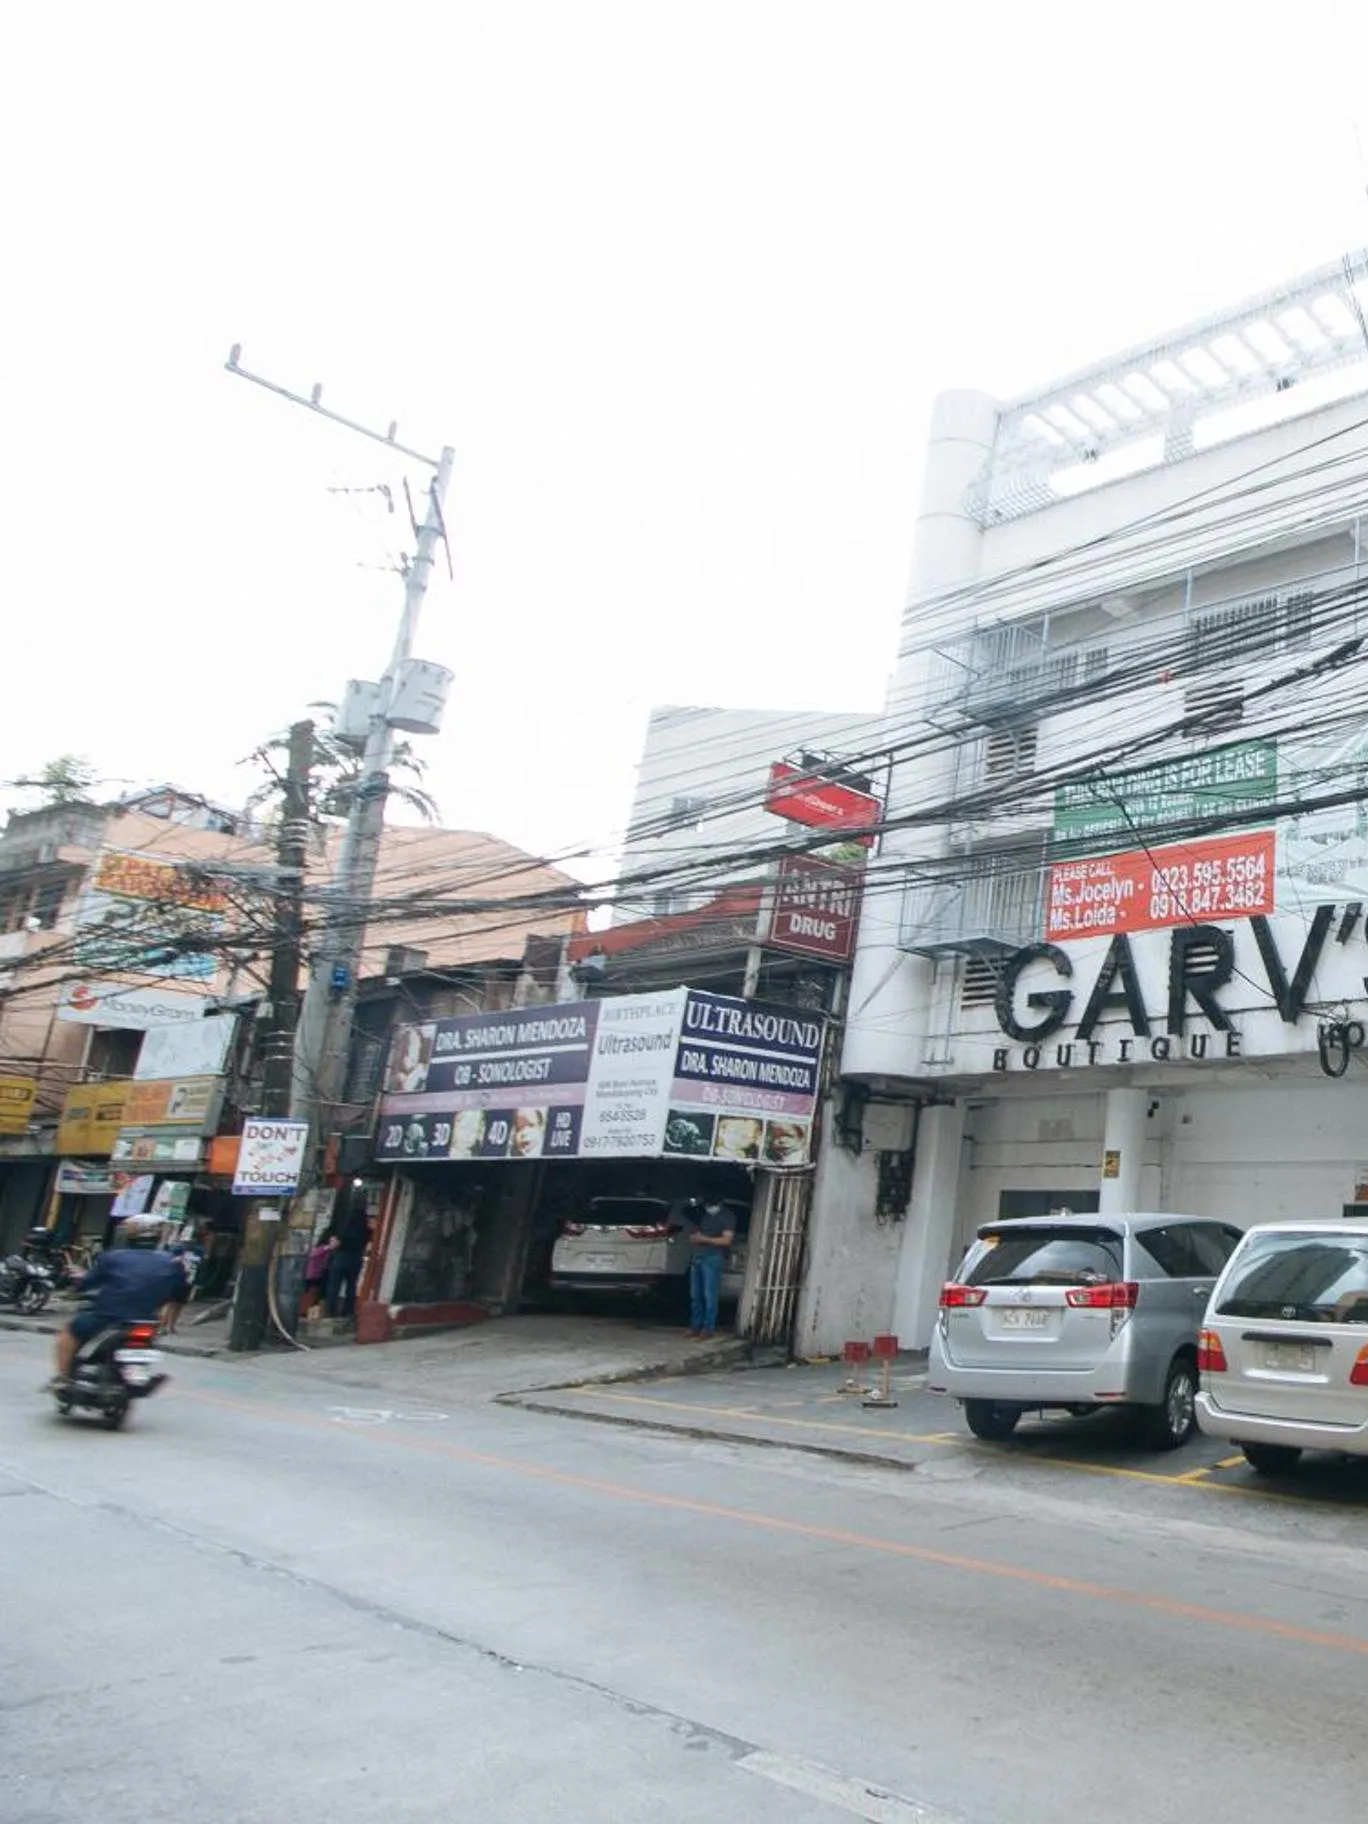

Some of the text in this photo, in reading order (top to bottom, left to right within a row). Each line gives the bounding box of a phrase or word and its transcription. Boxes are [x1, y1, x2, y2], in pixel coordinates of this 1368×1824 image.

[1214, 748, 1267, 783] LEASE
[1053, 866, 1088, 884] PLEASE
[790, 913, 837, 940] DRUG
[435, 1017, 587, 1052] DRA. SHARON MENDOZA
[686, 1000, 819, 1050] ULTRASOUND
[993, 1029, 1244, 1072] BOUTIQUE
[477, 1057, 552, 1084] SONOLOGIST
[681, 1050, 811, 1089] DRA. SHARON MENDOZA
[246, 1125, 307, 1141] DON'T
[556, 1111, 572, 1129] HD
[384, 1120, 508, 1148] 2D 3D 4D
[551, 1128, 572, 1148] LIVE
[239, 1171, 299, 1183] TOUCH
